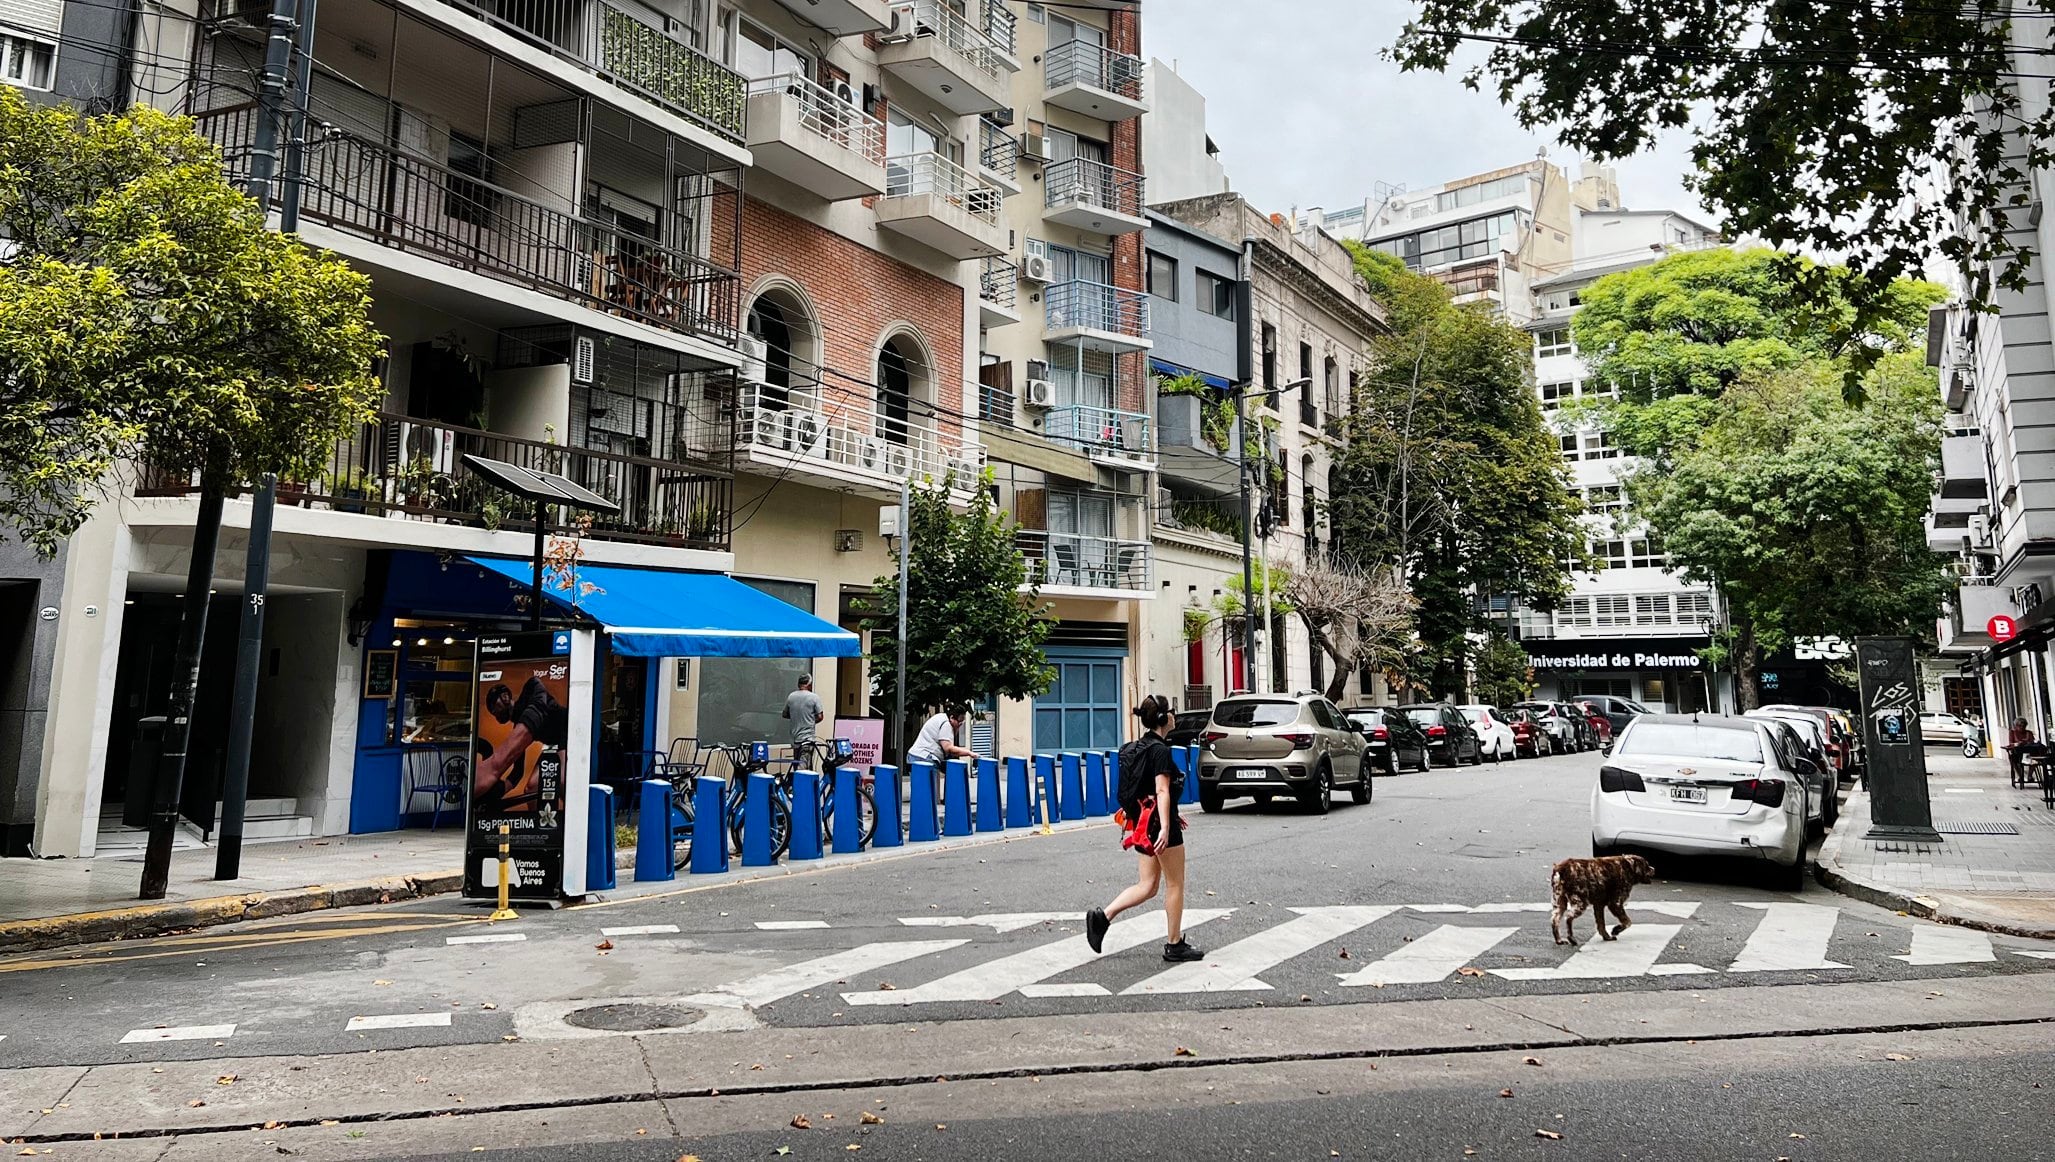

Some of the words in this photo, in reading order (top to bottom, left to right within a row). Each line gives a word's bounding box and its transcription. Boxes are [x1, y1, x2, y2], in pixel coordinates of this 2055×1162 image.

[250, 593, 264, 606] 35
[253, 604, 258, 615] 1
[1994, 619, 2010, 634] B
[481, 645, 512, 654] Billinghurst
[1611, 653, 1631, 667] de
[1634, 653, 1700, 667] Palermo
[533, 669, 549, 678] Yogur
[549, 664, 568, 675] Ser
[541, 760, 560, 772] Ser
[477, 819, 492, 832] 15g
[491, 817, 535, 830] PROTEÍNA
[515, 859, 540, 868] Vamos
[519, 868, 546, 877] Buenos
[522, 877, 543, 885] Aires
